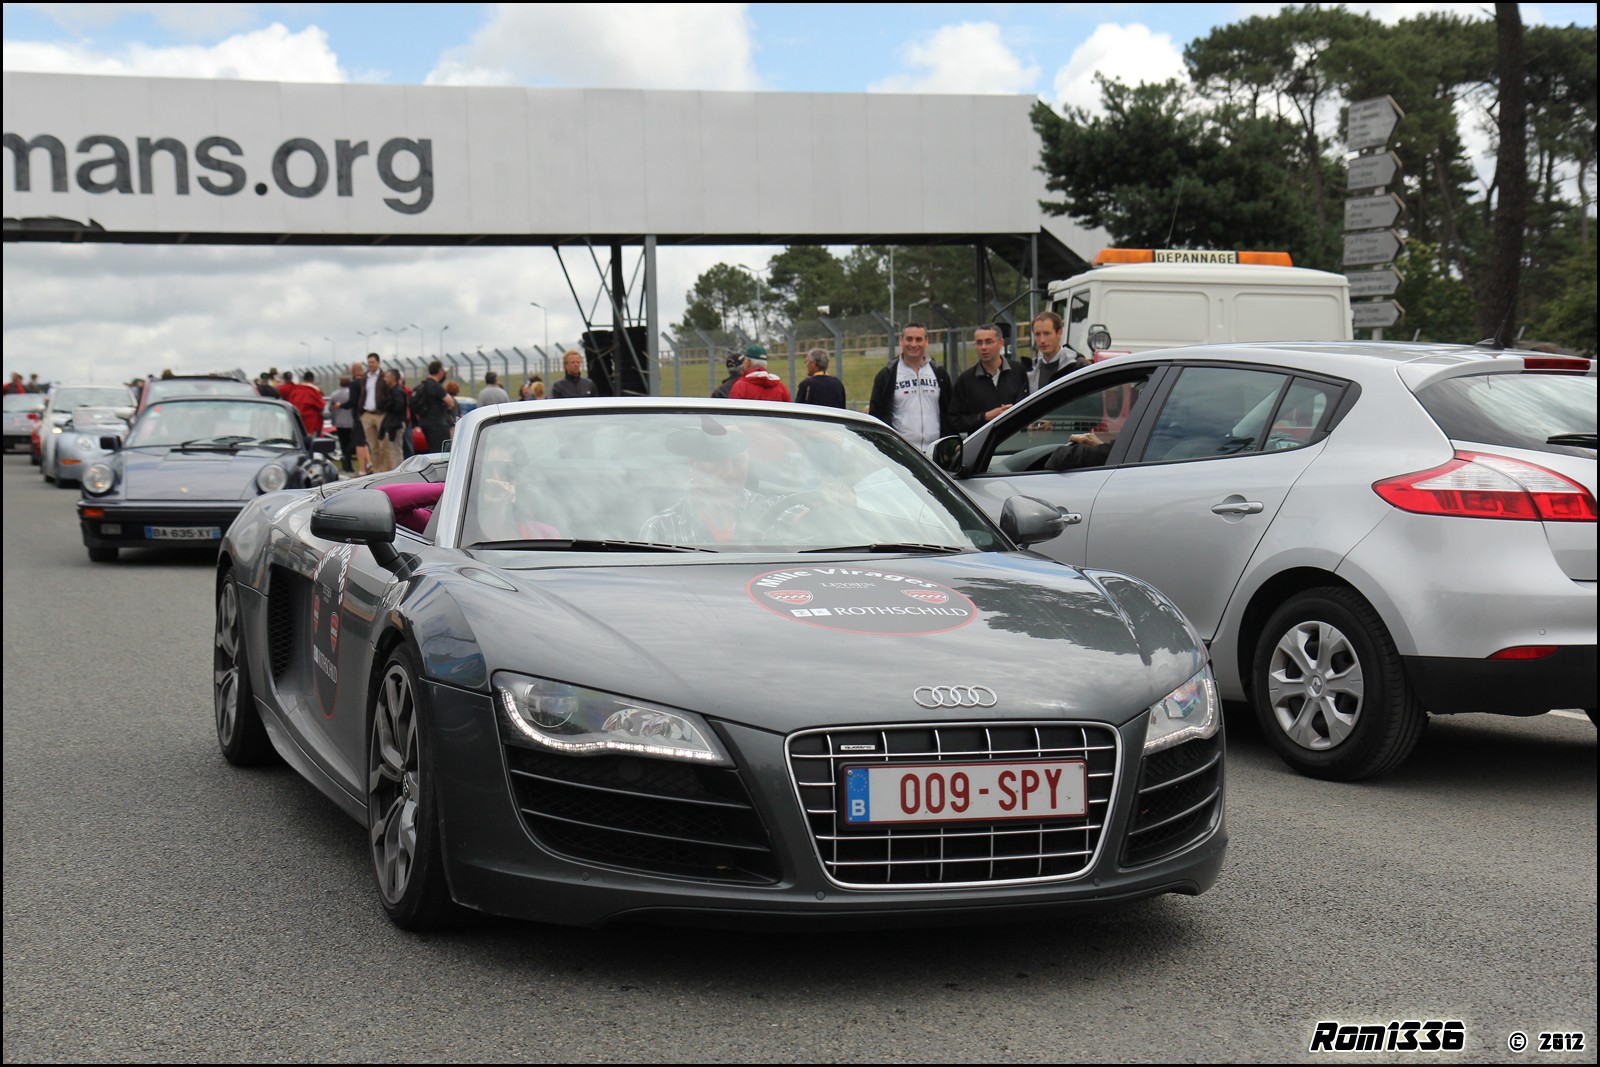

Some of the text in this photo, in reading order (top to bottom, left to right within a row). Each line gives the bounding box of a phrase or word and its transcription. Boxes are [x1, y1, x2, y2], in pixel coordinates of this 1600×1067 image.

[3, 132, 434, 215] mans.org
[755, 568, 938, 588] Mille Virages
[833, 606, 969, 617] ROTHSCHILD
[851, 799, 866, 817] B
